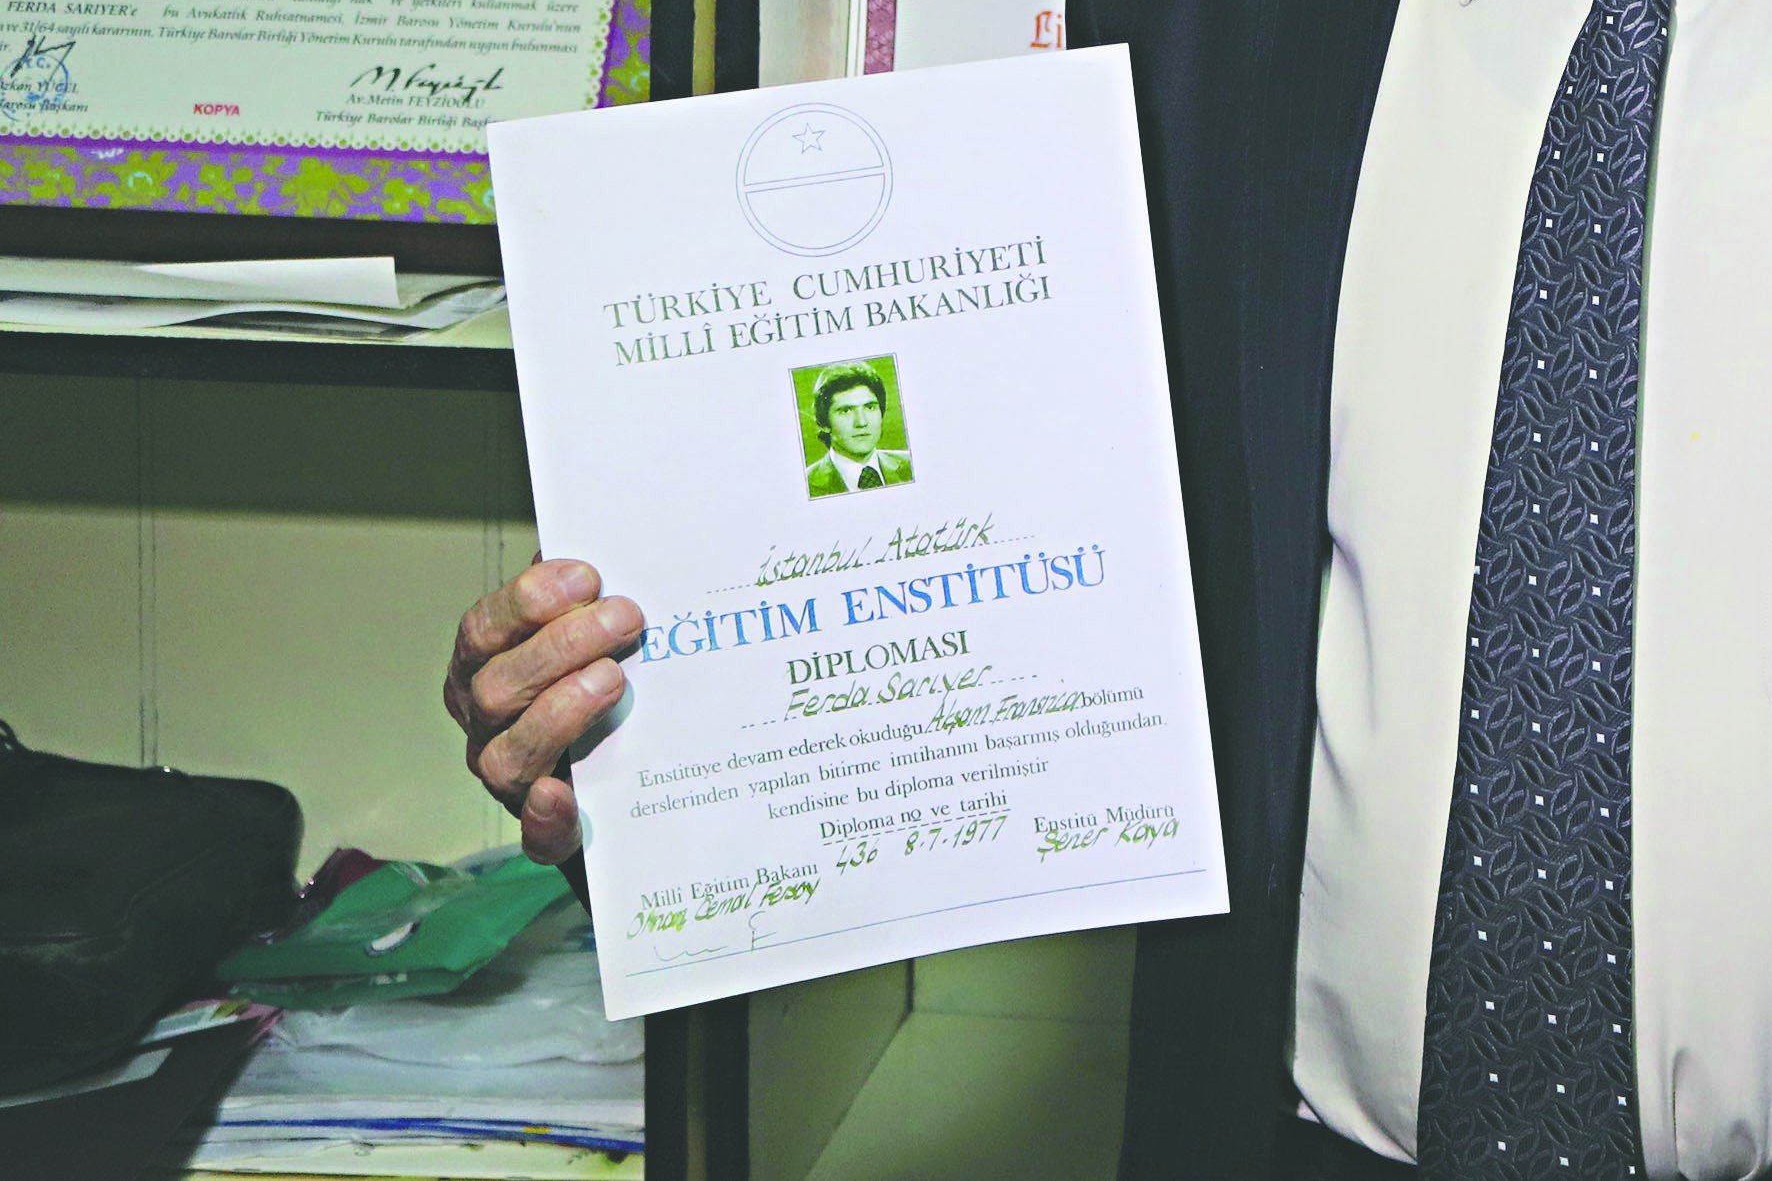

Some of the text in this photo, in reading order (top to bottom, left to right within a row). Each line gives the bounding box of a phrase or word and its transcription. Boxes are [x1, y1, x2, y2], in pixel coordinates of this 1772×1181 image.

[8, 1, 56, 14] FERDA
[64, 1, 138, 17] SARIYER'e
[397, 15, 440, 28] Barosu
[194, 103, 240, 116] KOPYA
[603, 235, 1047, 329] TÜRKİYE CUMHURİYETİ
[613, 273, 1052, 366] MİLLÎ EĞİTİM BAKANLIĞI
[875, 512, 995, 564] Atatürk
[639, 544, 1106, 663] EĞİTİM ENSTİTÜSÜ
[786, 630, 970, 685] DİPLOMASI
[783, 665, 992, 723] Ferda Sarıyer
[639, 760, 721, 788] Enstitüye
[727, 746, 783, 770] devam
[789, 732, 847, 758] ederek
[849, 721, 924, 748] okuduğu
[1080, 687, 1144, 710] bölümü
[630, 786, 739, 819] derslerinden
[748, 770, 810, 798] yapılan
[819, 758, 881, 782] bitirme
[890, 740, 978, 768] imtihanını
[986, 730, 1060, 750] başarmış
[768, 757, 1049, 820] kendisine bu diploma verilmiştir
[819, 813, 895, 840] Diploma
[931, 802, 950, 817] ve
[960, 789, 1008, 813] tarihi
[1034, 803, 1174, 834] Enstitü Müdürü
[1115, 818, 1180, 849] Kaya
[691, 863, 819, 902] Eğitim Bakanı
